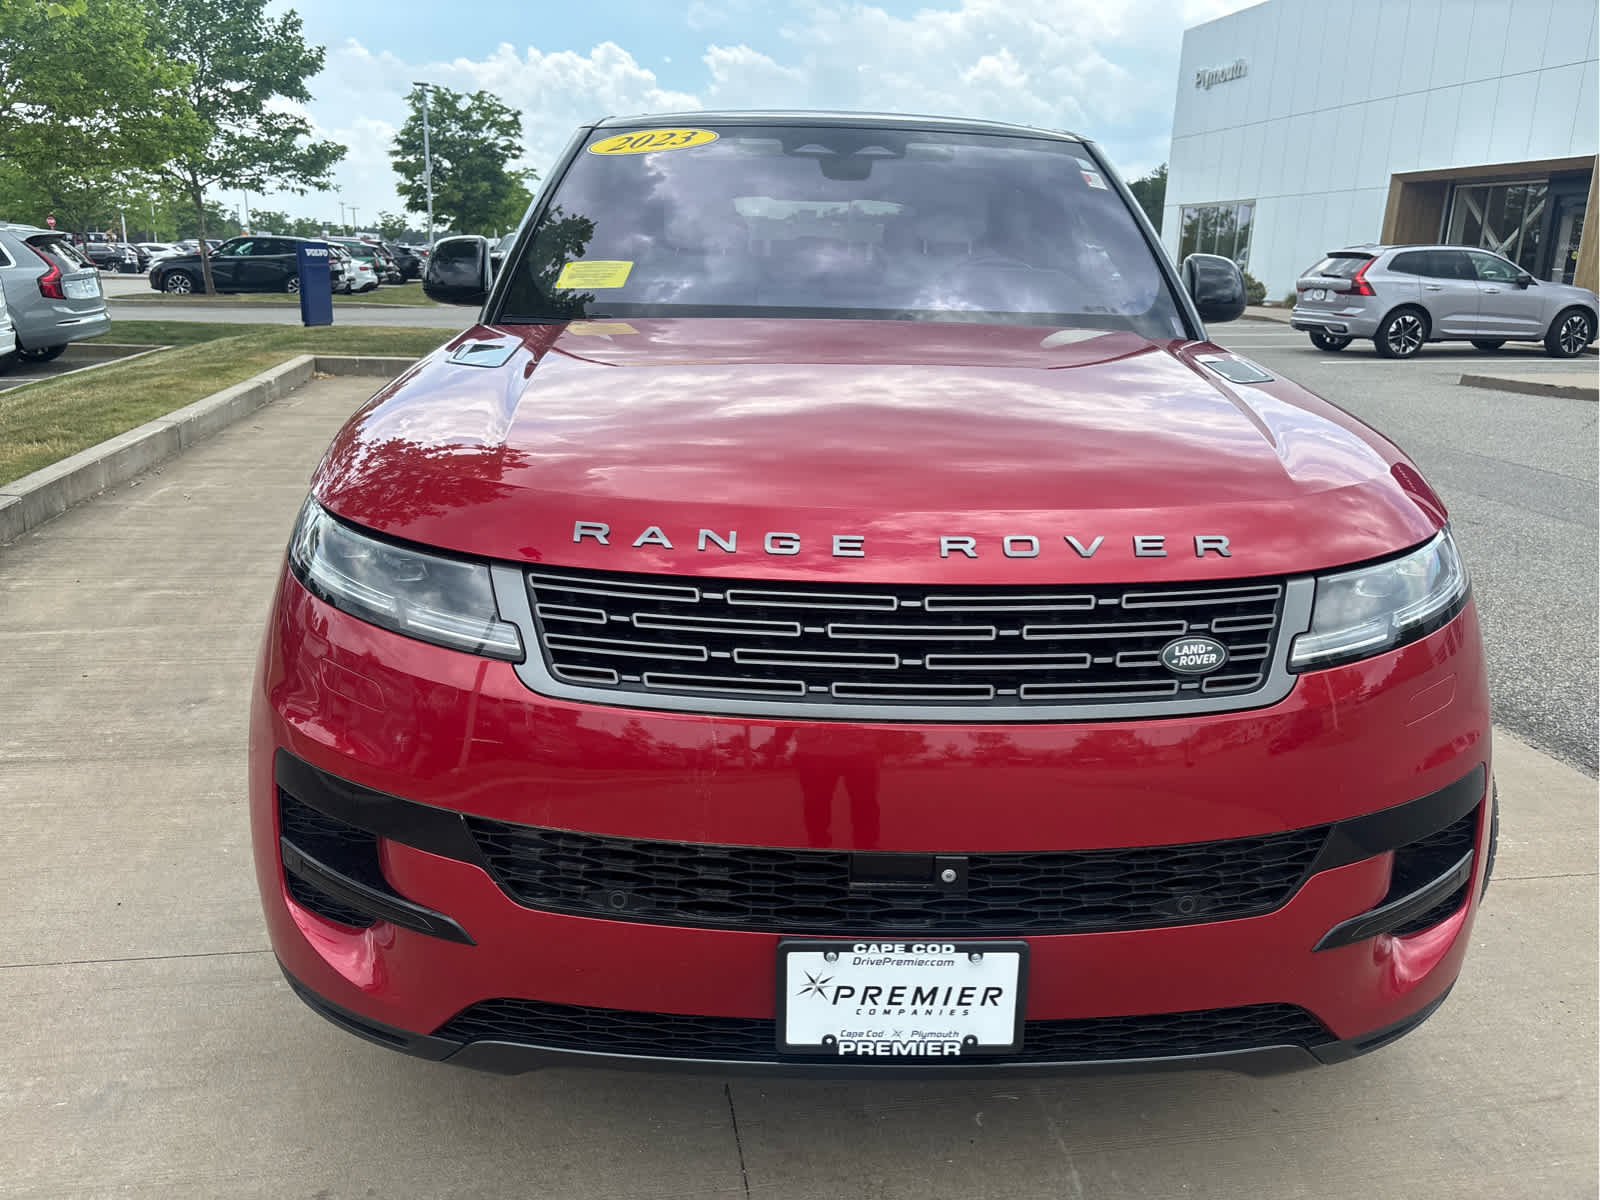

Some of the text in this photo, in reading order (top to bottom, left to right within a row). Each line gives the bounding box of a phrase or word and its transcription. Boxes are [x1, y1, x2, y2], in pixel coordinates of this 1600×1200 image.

[1195, 59, 1248, 91] Plymouth
[605, 130, 699, 153] 2023
[304, 248, 329, 257] VOLVO
[572, 520, 1232, 558] RANGE ROVER
[852, 943, 956, 954] CAPE COD
[852, 956, 956, 967] DrivePremier.com
[831, 985, 1004, 1007] PREMIER
[855, 1008, 970, 1016] COMPANIES
[839, 1029, 960, 1040] Cape Cod Plymouth
[838, 1040, 961, 1056] PREMIER
